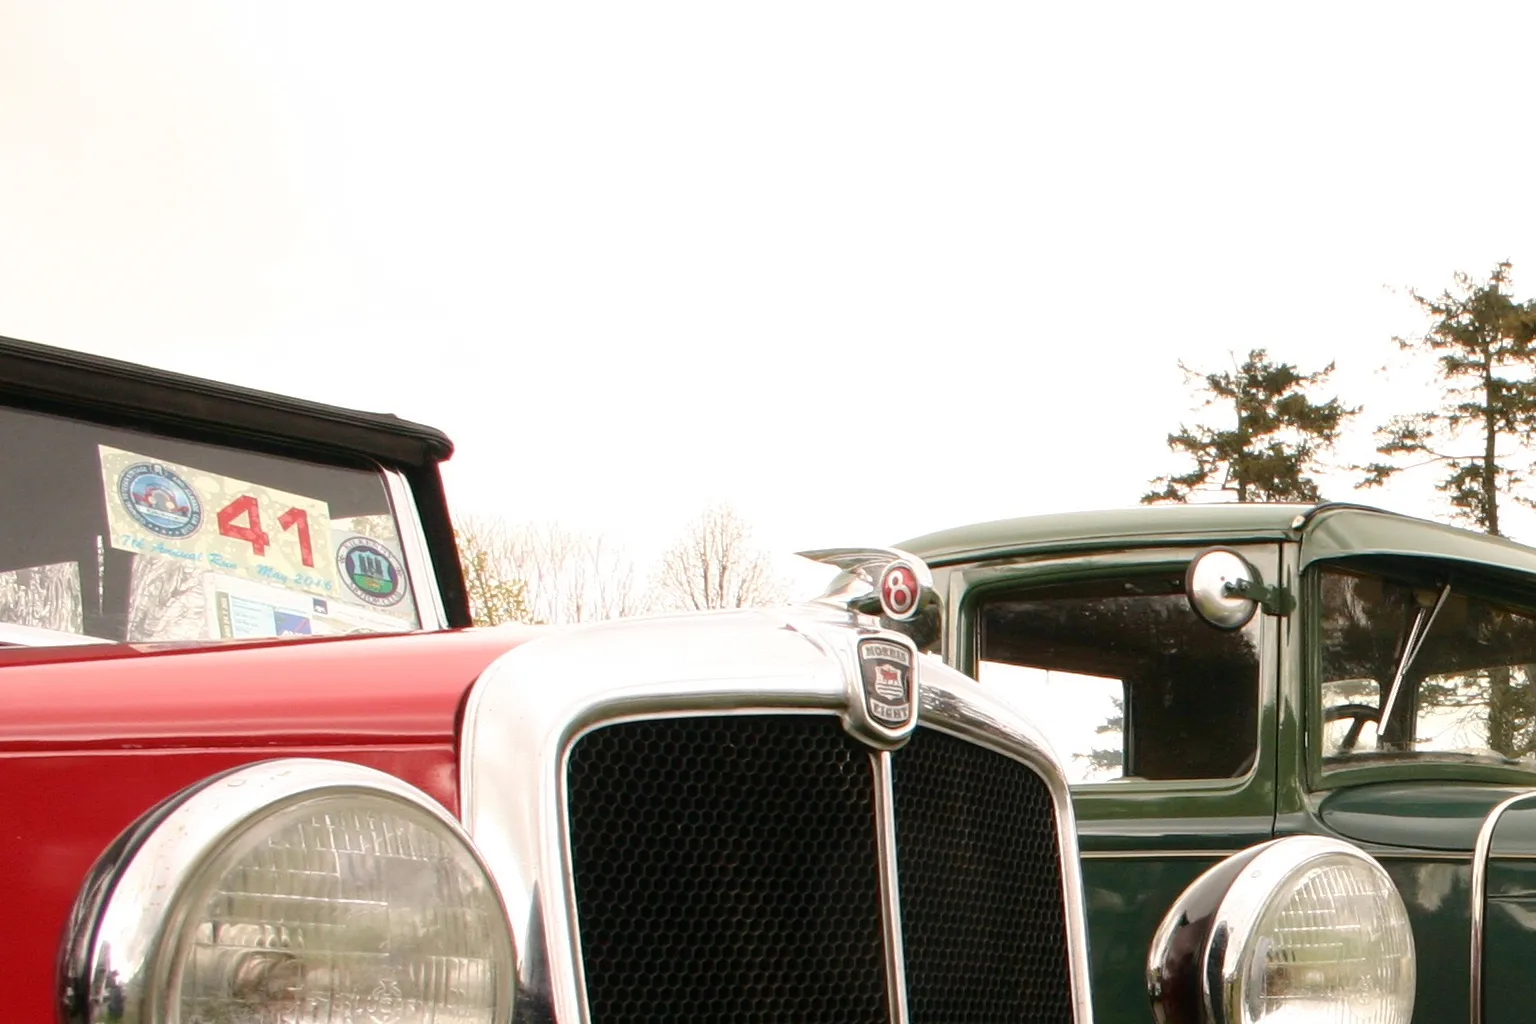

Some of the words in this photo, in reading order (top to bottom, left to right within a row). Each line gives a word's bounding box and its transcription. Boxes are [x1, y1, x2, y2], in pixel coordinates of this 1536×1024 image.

[217, 494, 314, 568] 41
[152, 542, 203, 561] Annual
[208, 552, 238, 569] Run
[256, 564, 288, 583] May
[888, 570, 912, 612] 8
[865, 645, 907, 662] MORRIS
[873, 702, 908, 719] EIGHT
